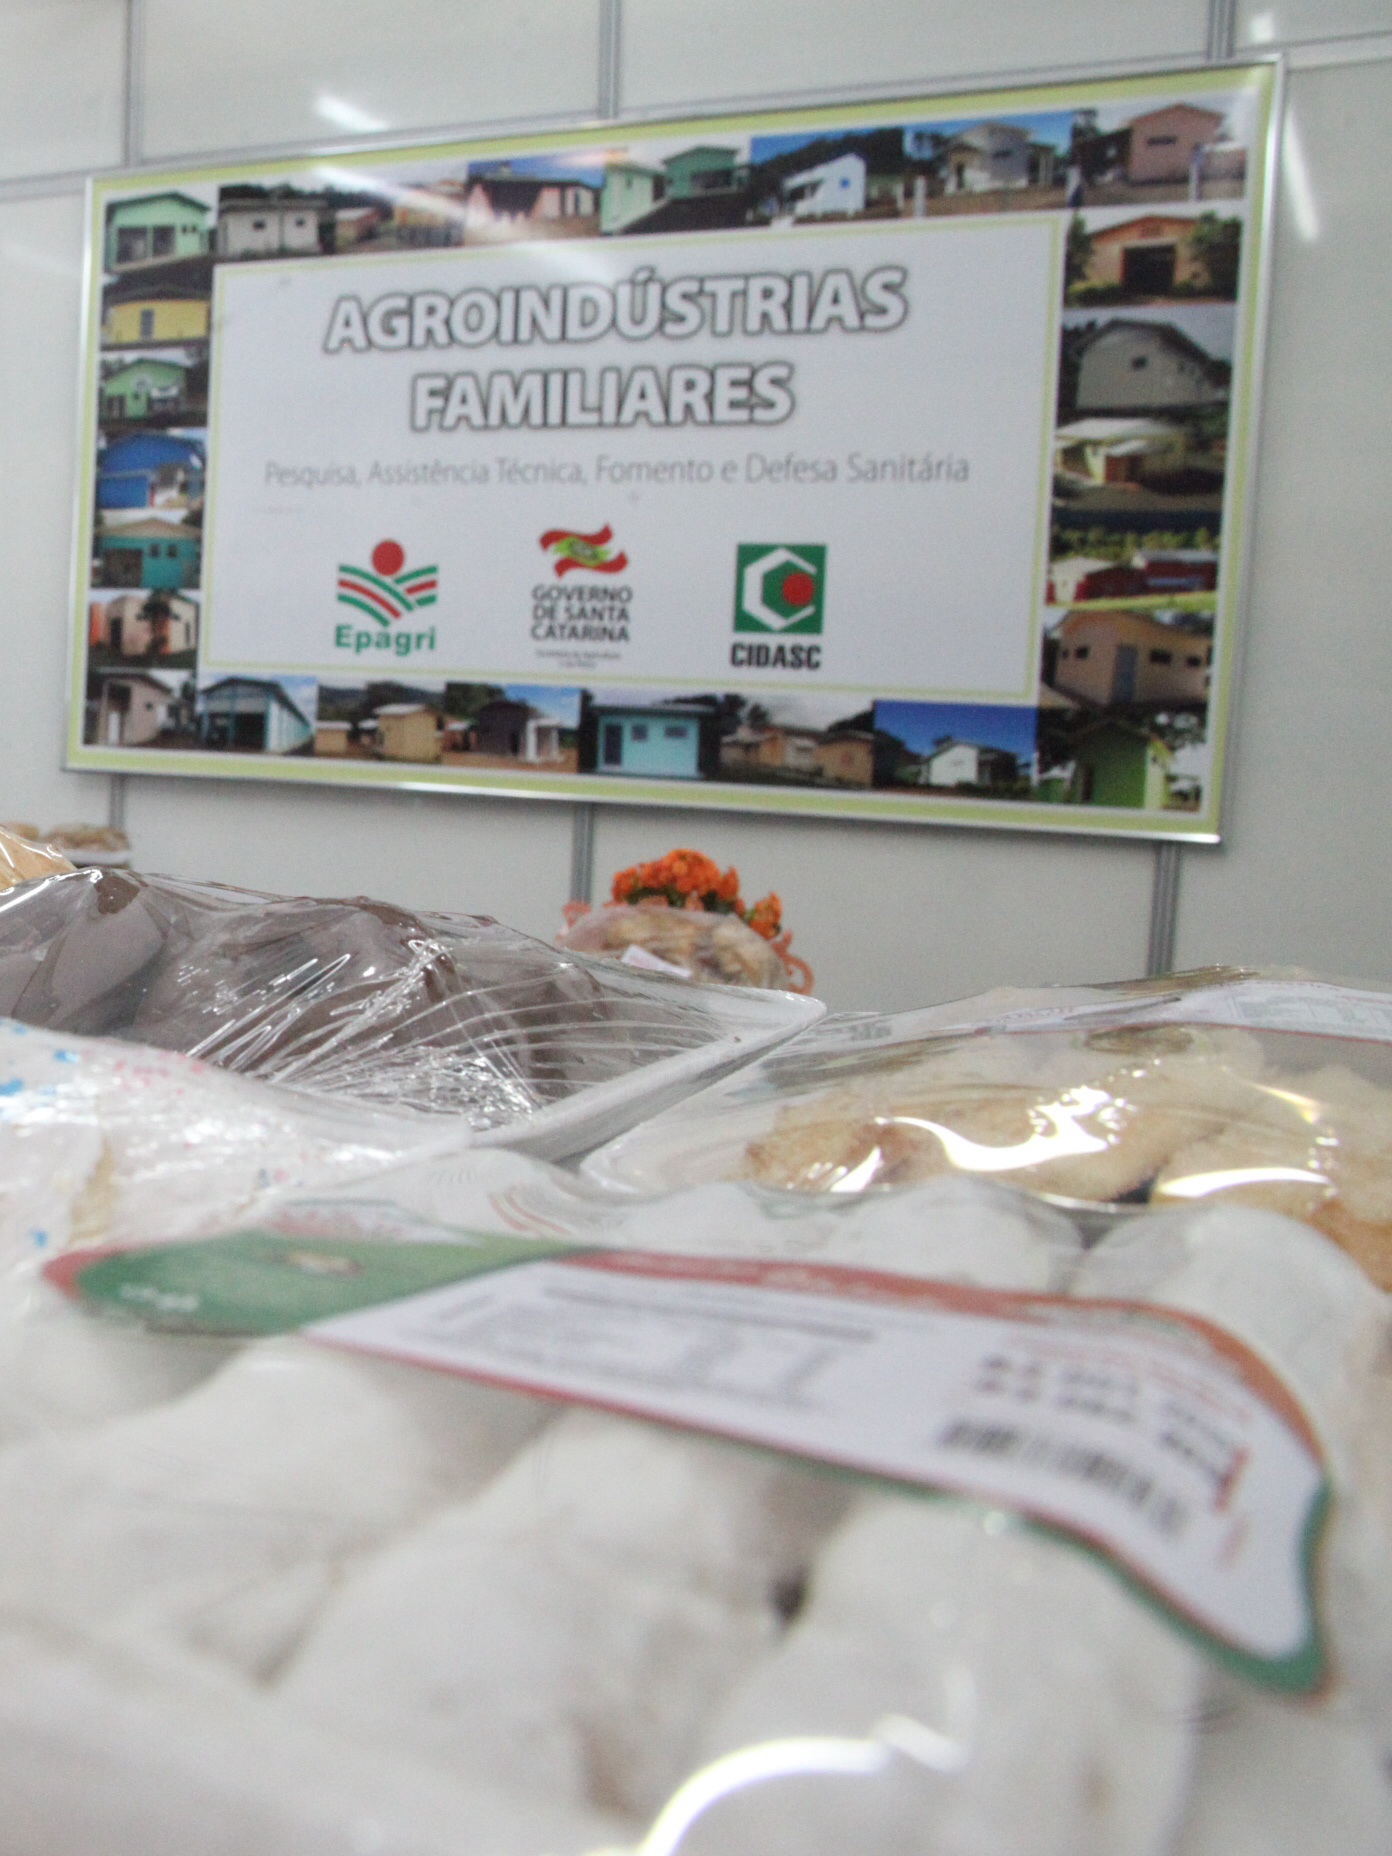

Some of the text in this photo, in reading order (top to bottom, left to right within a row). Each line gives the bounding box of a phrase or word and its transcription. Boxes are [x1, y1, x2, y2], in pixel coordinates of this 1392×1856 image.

[324, 265, 909, 353] AGROINDÚSTRIAS
[411, 361, 796, 431] FAMILIARES
[264, 452, 970, 488] Pesquisa, Assistência Técnica, Fomento e Defesa Sanitária
[531, 586, 633, 604] GOVERNO
[532, 606, 629, 622] DE SANTA
[335, 625, 436, 656] Epagri
[531, 624, 629, 641] CATARINA
[730, 642, 822, 669] CIDASC
